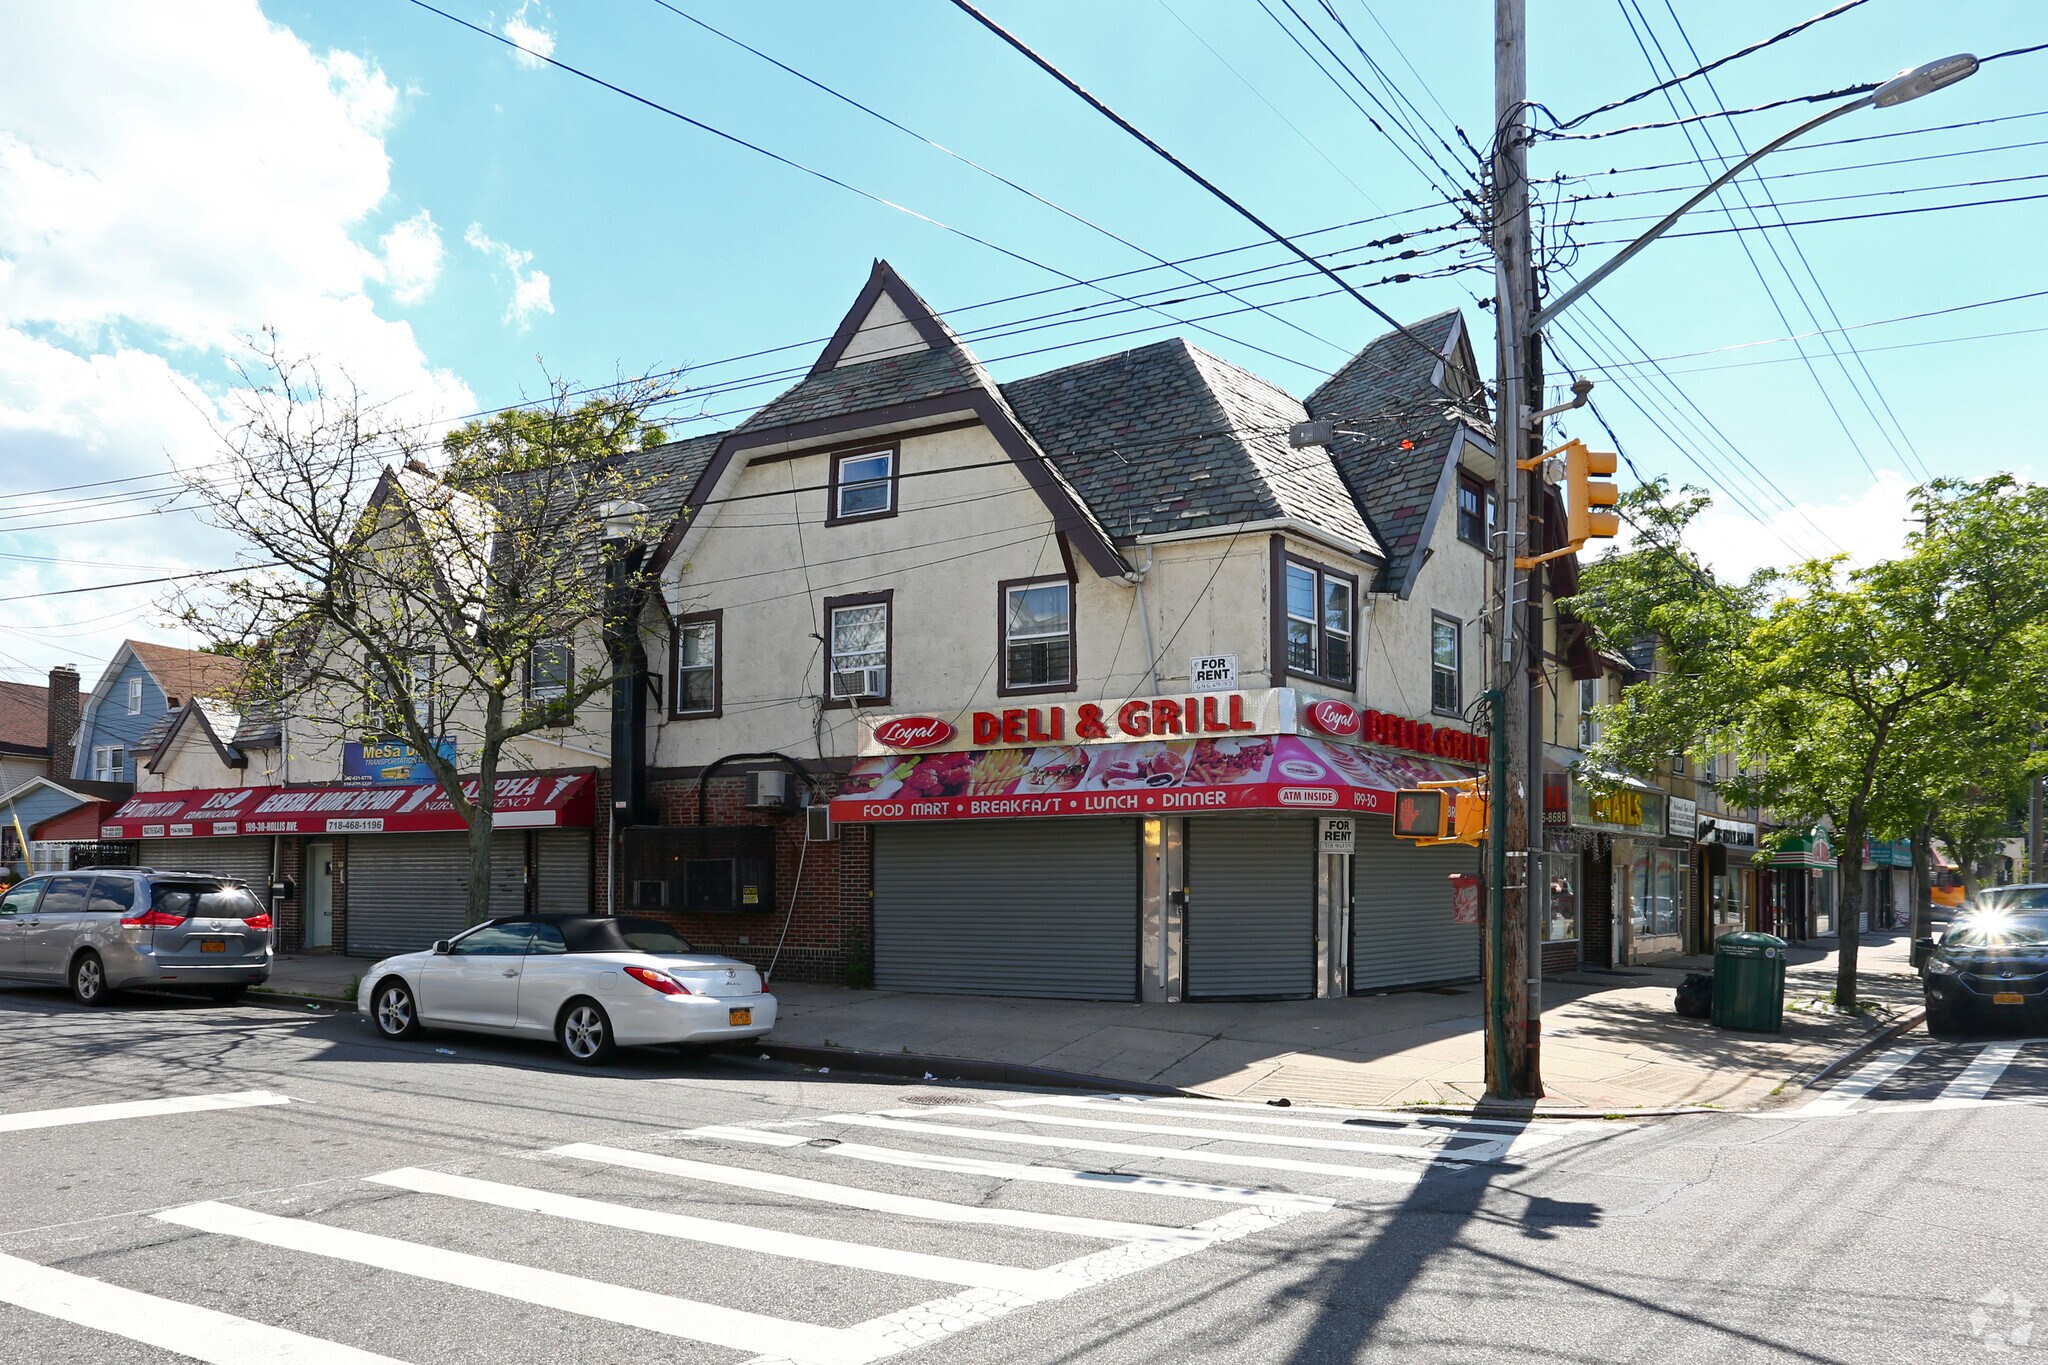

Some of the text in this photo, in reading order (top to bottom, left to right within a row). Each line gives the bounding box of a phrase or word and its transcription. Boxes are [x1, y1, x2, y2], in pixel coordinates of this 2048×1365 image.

[1201, 658, 1226, 669] FOR
[1197, 668, 1230, 681] RENT
[972, 694, 1256, 745] DELI & GRILL
[1321, 704, 1353, 730] Loyal
[882, 720, 939, 746] Loyal
[1363, 709, 1417, 750] DELI
[1418, 722, 1434, 754] &
[363, 744, 401, 759] MeSa
[254, 789, 407, 813] GENERAL HOME REPAIR
[493, 797, 536, 808] GENCY
[1283, 791, 1333, 802] ATM INSIDE
[1353, 791, 1378, 808] 199-30
[863, 791, 1227, 817] FOOD MART BREAKFAST LUNCH DINNER
[245, 823, 286, 832] 199-30-HOLLIS
[328, 819, 383, 830] 718-468-1196
[1329, 820, 1350, 830] FOR
[1324, 831, 1352, 841] RENT
